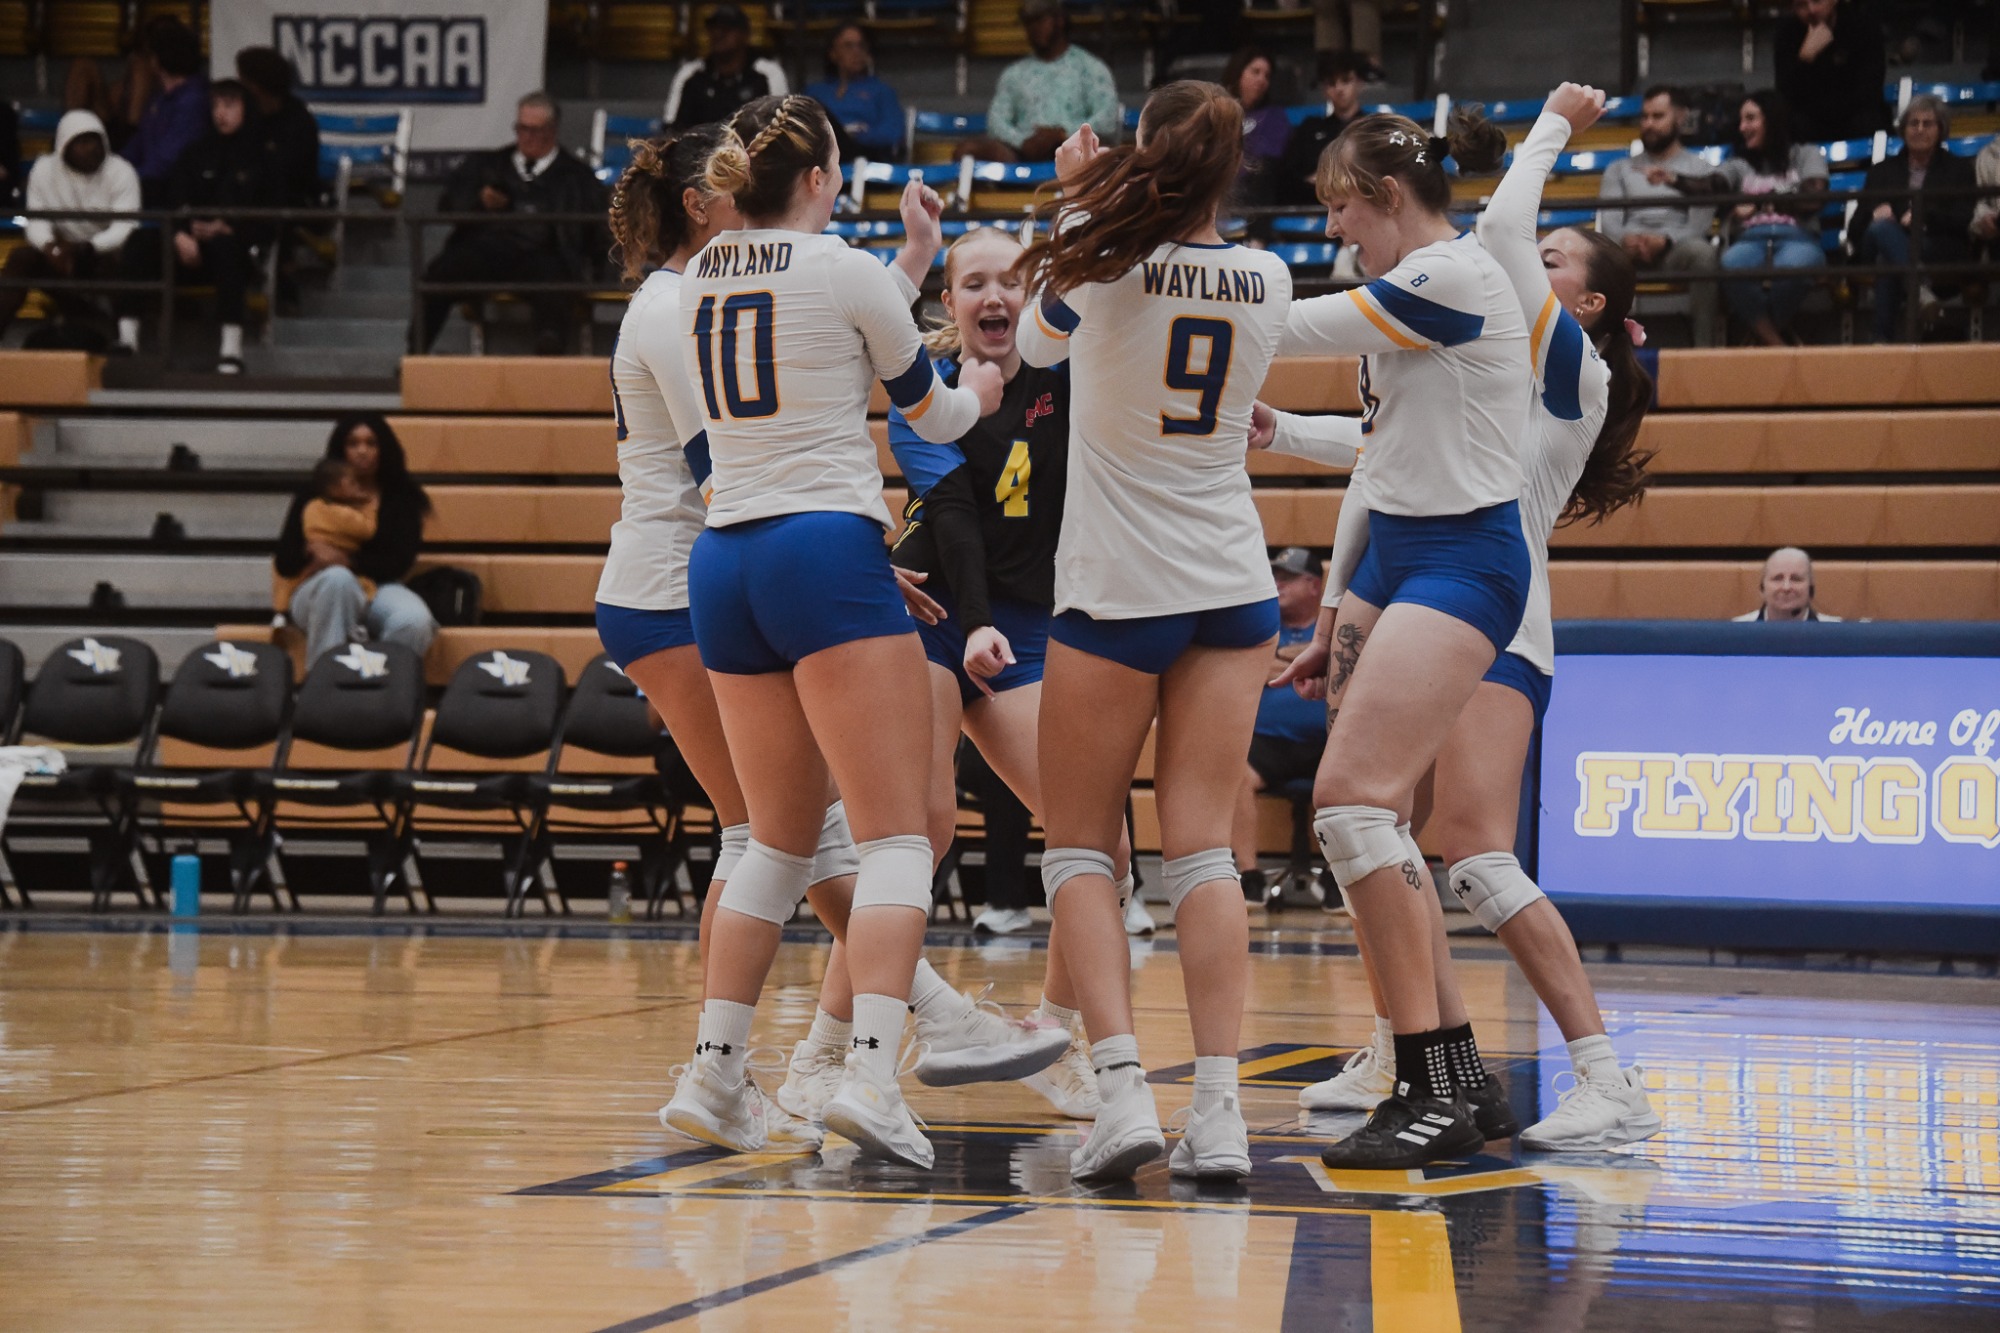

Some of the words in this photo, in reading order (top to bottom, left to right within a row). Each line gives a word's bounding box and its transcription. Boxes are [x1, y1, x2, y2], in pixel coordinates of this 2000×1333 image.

[276, 19, 484, 88] NCCAA
[696, 242, 793, 279] WAYLAND
[1142, 261, 1266, 305] WAYLAND
[1410, 273, 1430, 288] 8
[691, 289, 781, 422] 10
[1159, 313, 1236, 437] 9
[994, 439, 1032, 518] 4
[1829, 707, 1938, 746] Home
[1949, 708, 2000, 756] Of
[1574, 751, 1926, 845] FLYING
